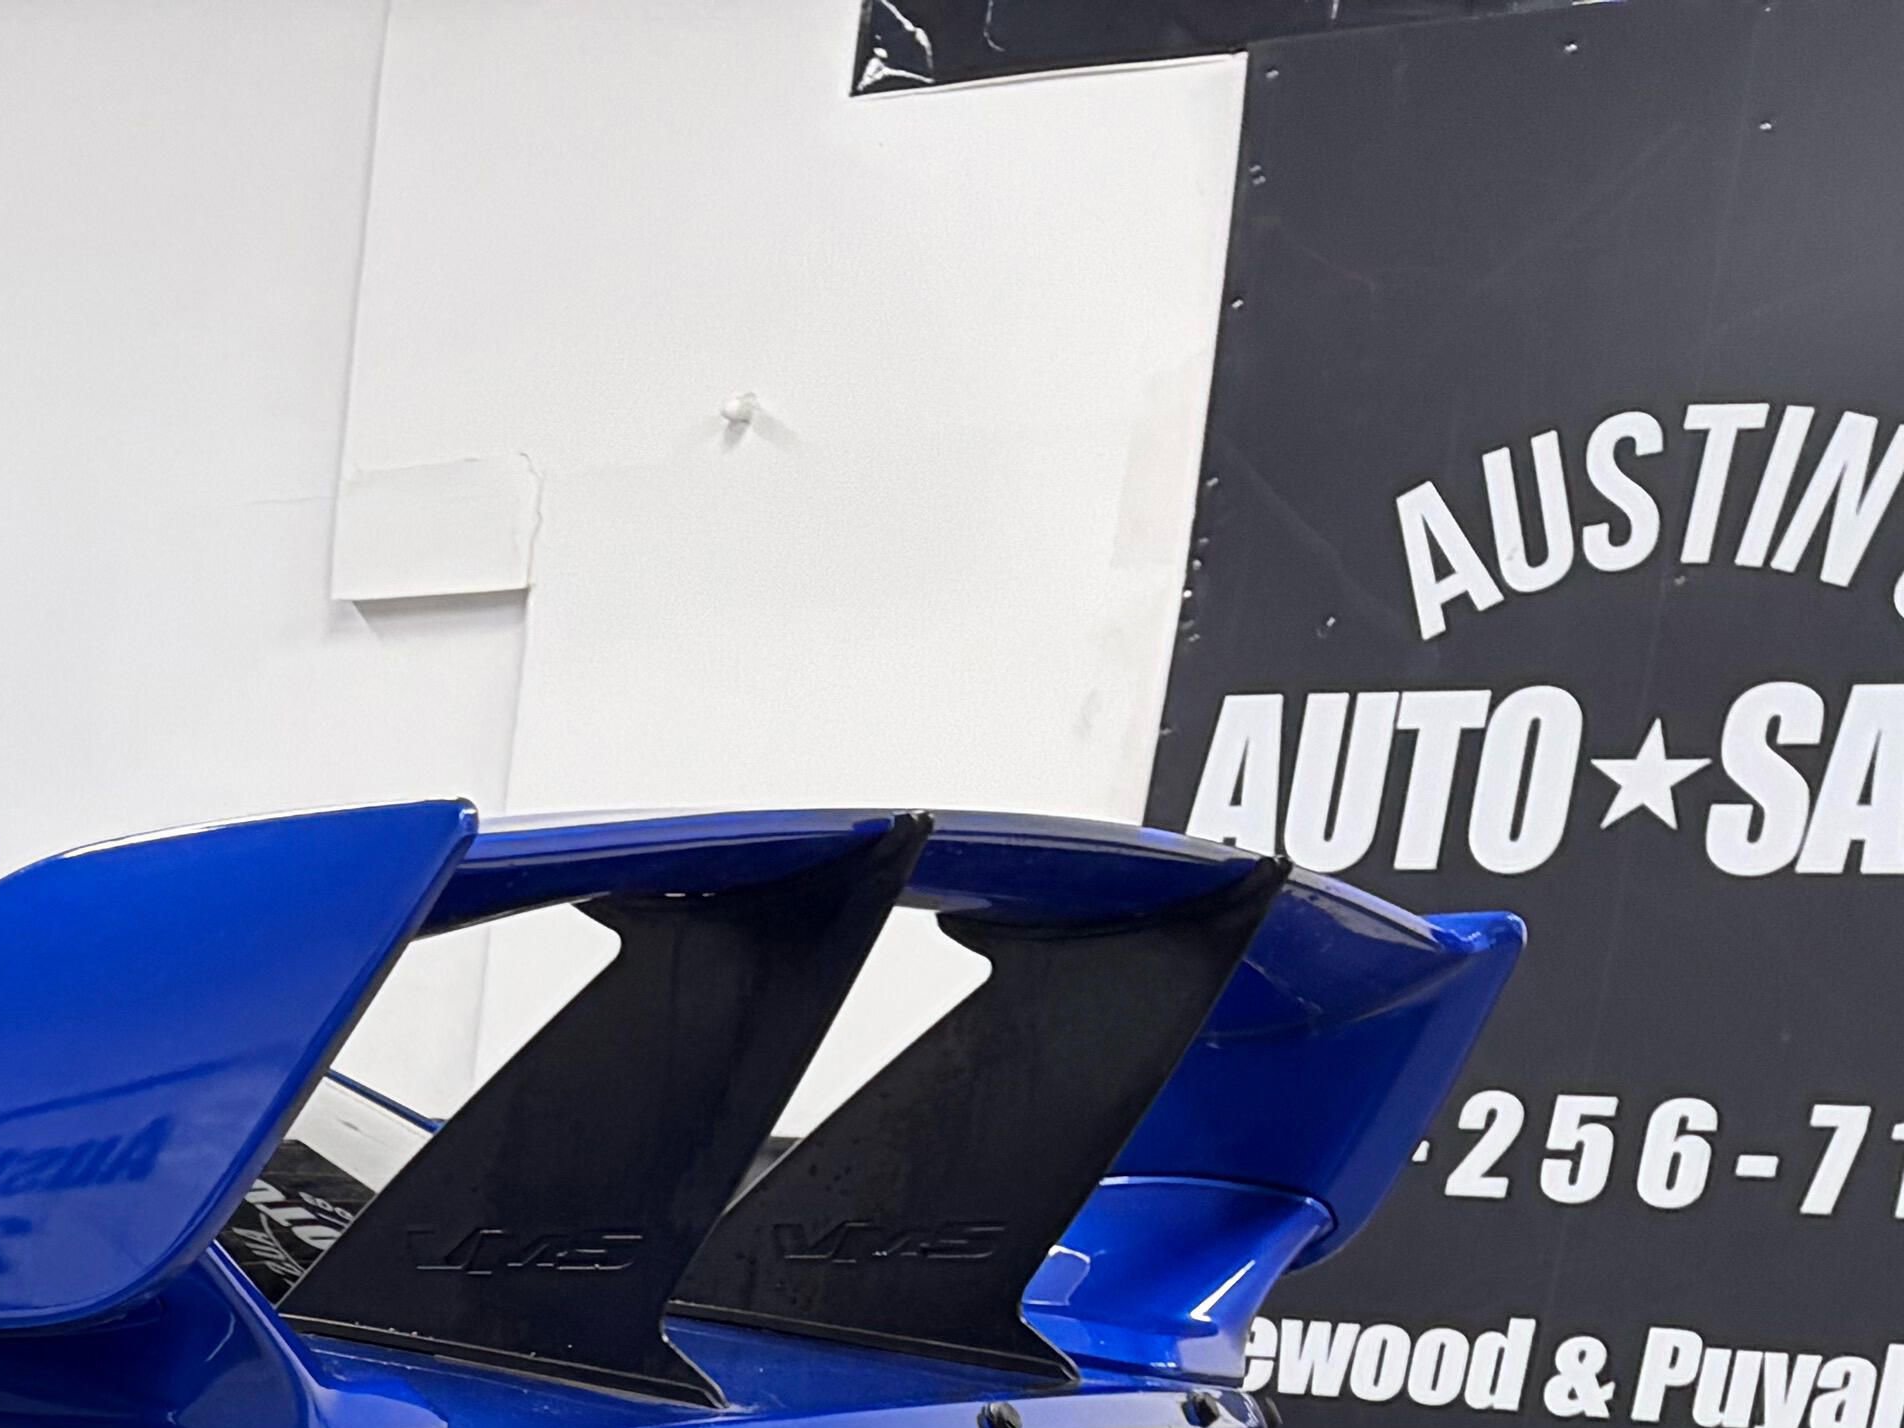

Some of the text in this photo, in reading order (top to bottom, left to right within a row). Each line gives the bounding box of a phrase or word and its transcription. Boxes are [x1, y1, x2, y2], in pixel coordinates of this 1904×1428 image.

[1396, 402, 1904, 640] AUSTIN
[1186, 684, 1583, 875] AUTO
[1543, 1335, 1616, 1419] &
